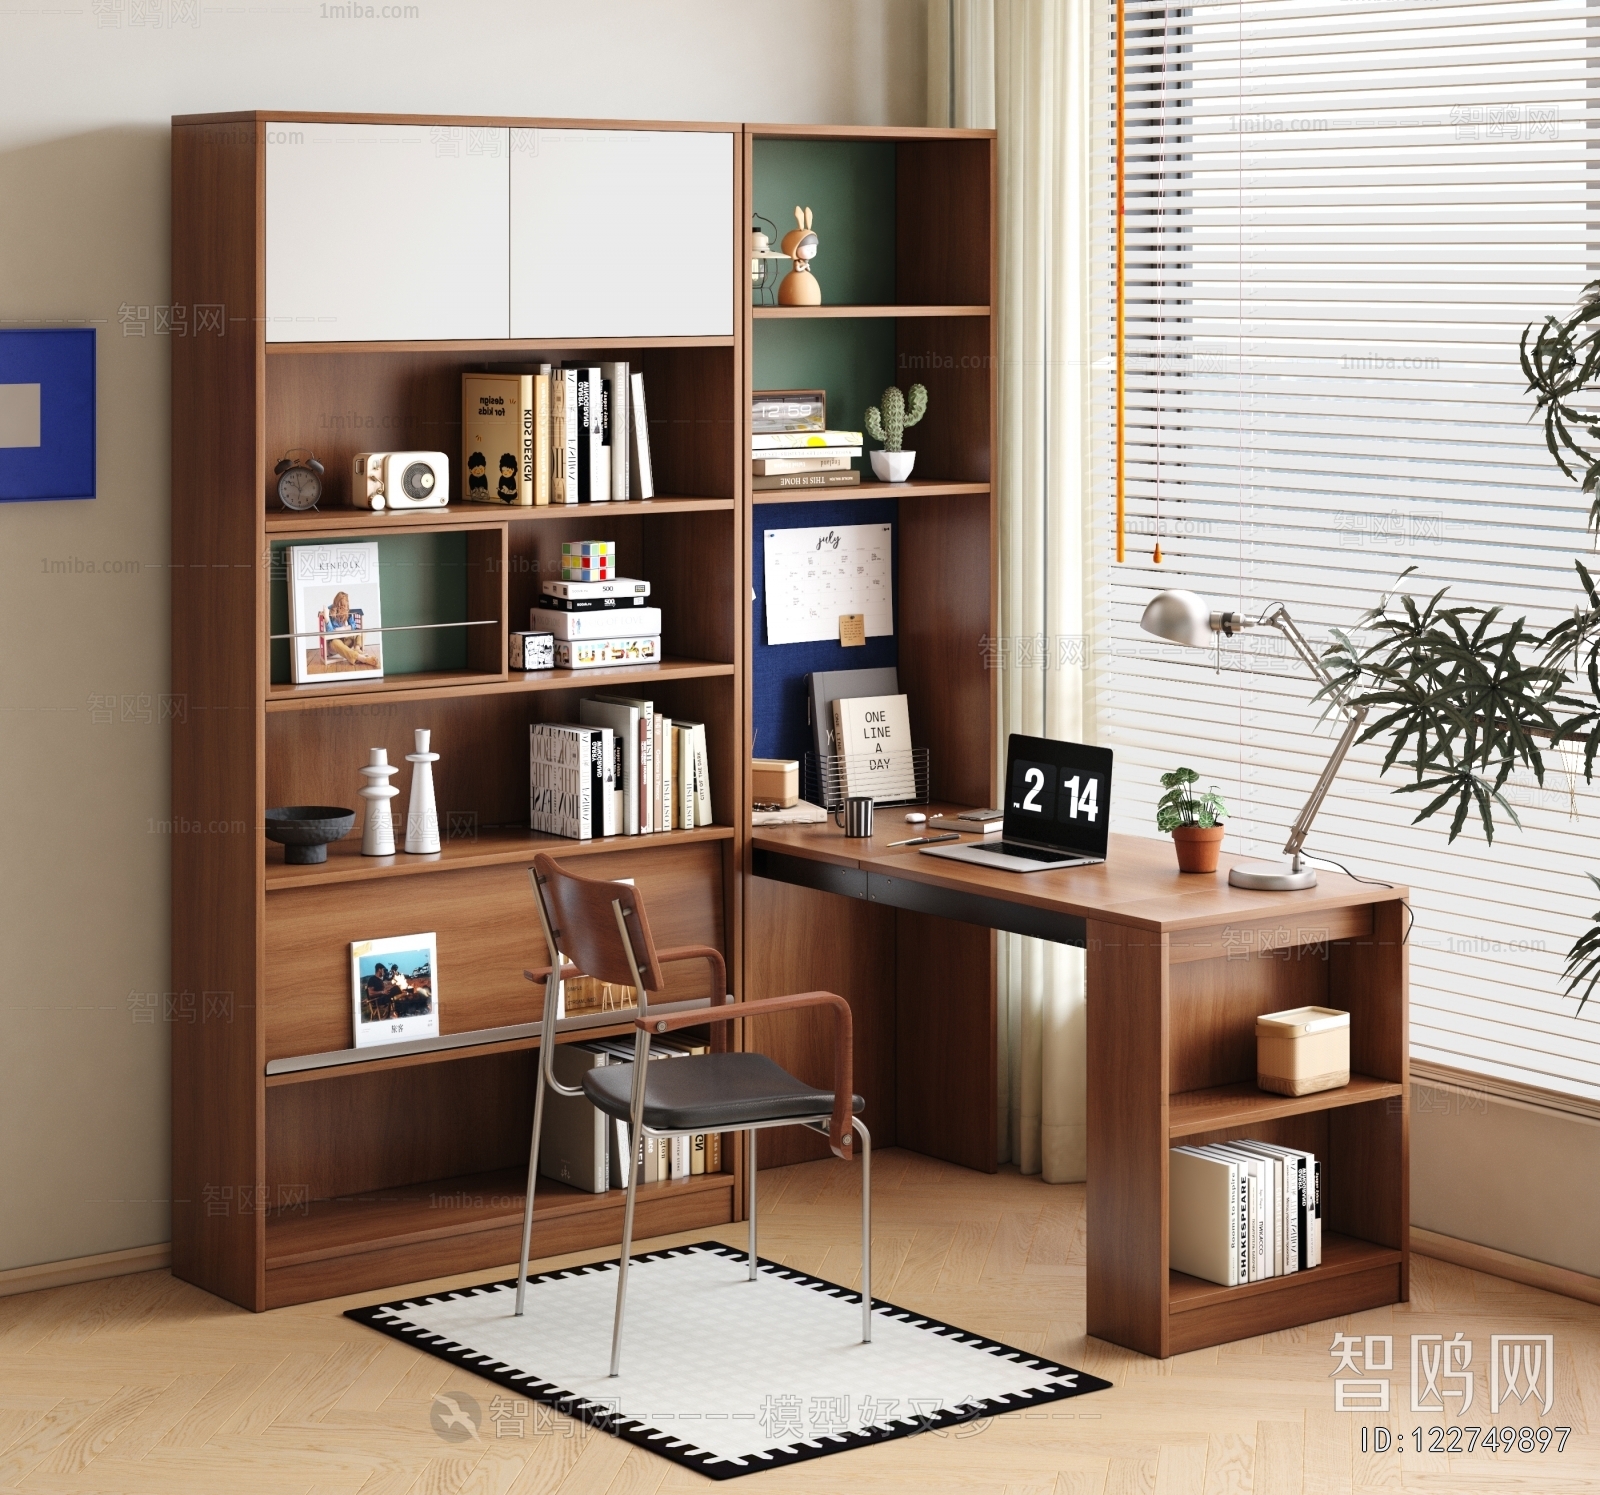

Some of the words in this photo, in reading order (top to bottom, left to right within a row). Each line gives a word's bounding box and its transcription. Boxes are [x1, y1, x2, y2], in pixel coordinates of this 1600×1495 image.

[820, 458, 841, 467] England
[780, 477, 801, 486] HOME
[812, 476, 826, 484] THIS
[816, 530, 841, 551] july
[319, 561, 361, 571] KINFOLK
[865, 710, 886, 723] ONE
[863, 726, 891, 739] LINE
[875, 743, 883, 753] A
[869, 758, 891, 770] DAY
[1022, 767, 1045, 813] 2
[1064, 775, 1099, 822] 14
